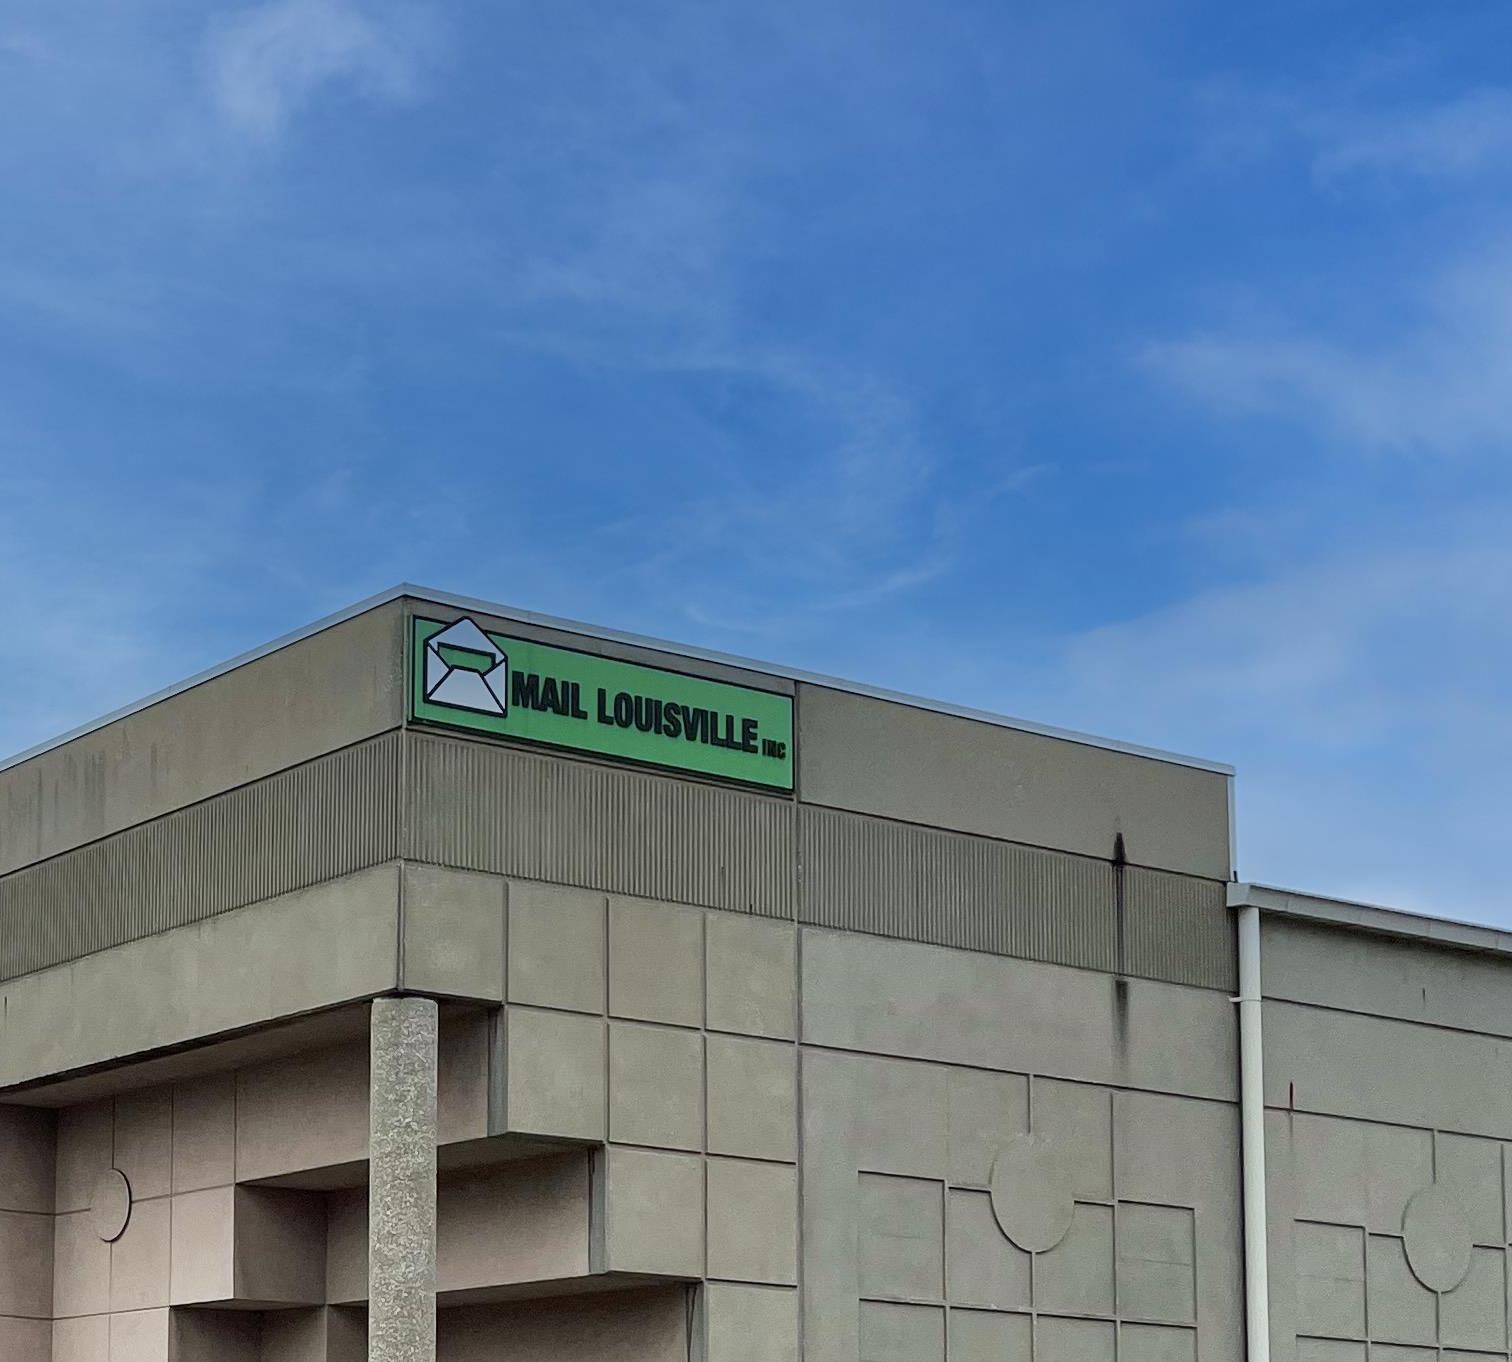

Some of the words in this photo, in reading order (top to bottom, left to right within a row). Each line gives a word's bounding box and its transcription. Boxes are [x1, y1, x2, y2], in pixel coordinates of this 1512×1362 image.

[511, 671, 588, 720] MAIL
[597, 688, 759, 754] LOUISVILLE
[761, 738, 786, 760] INC
